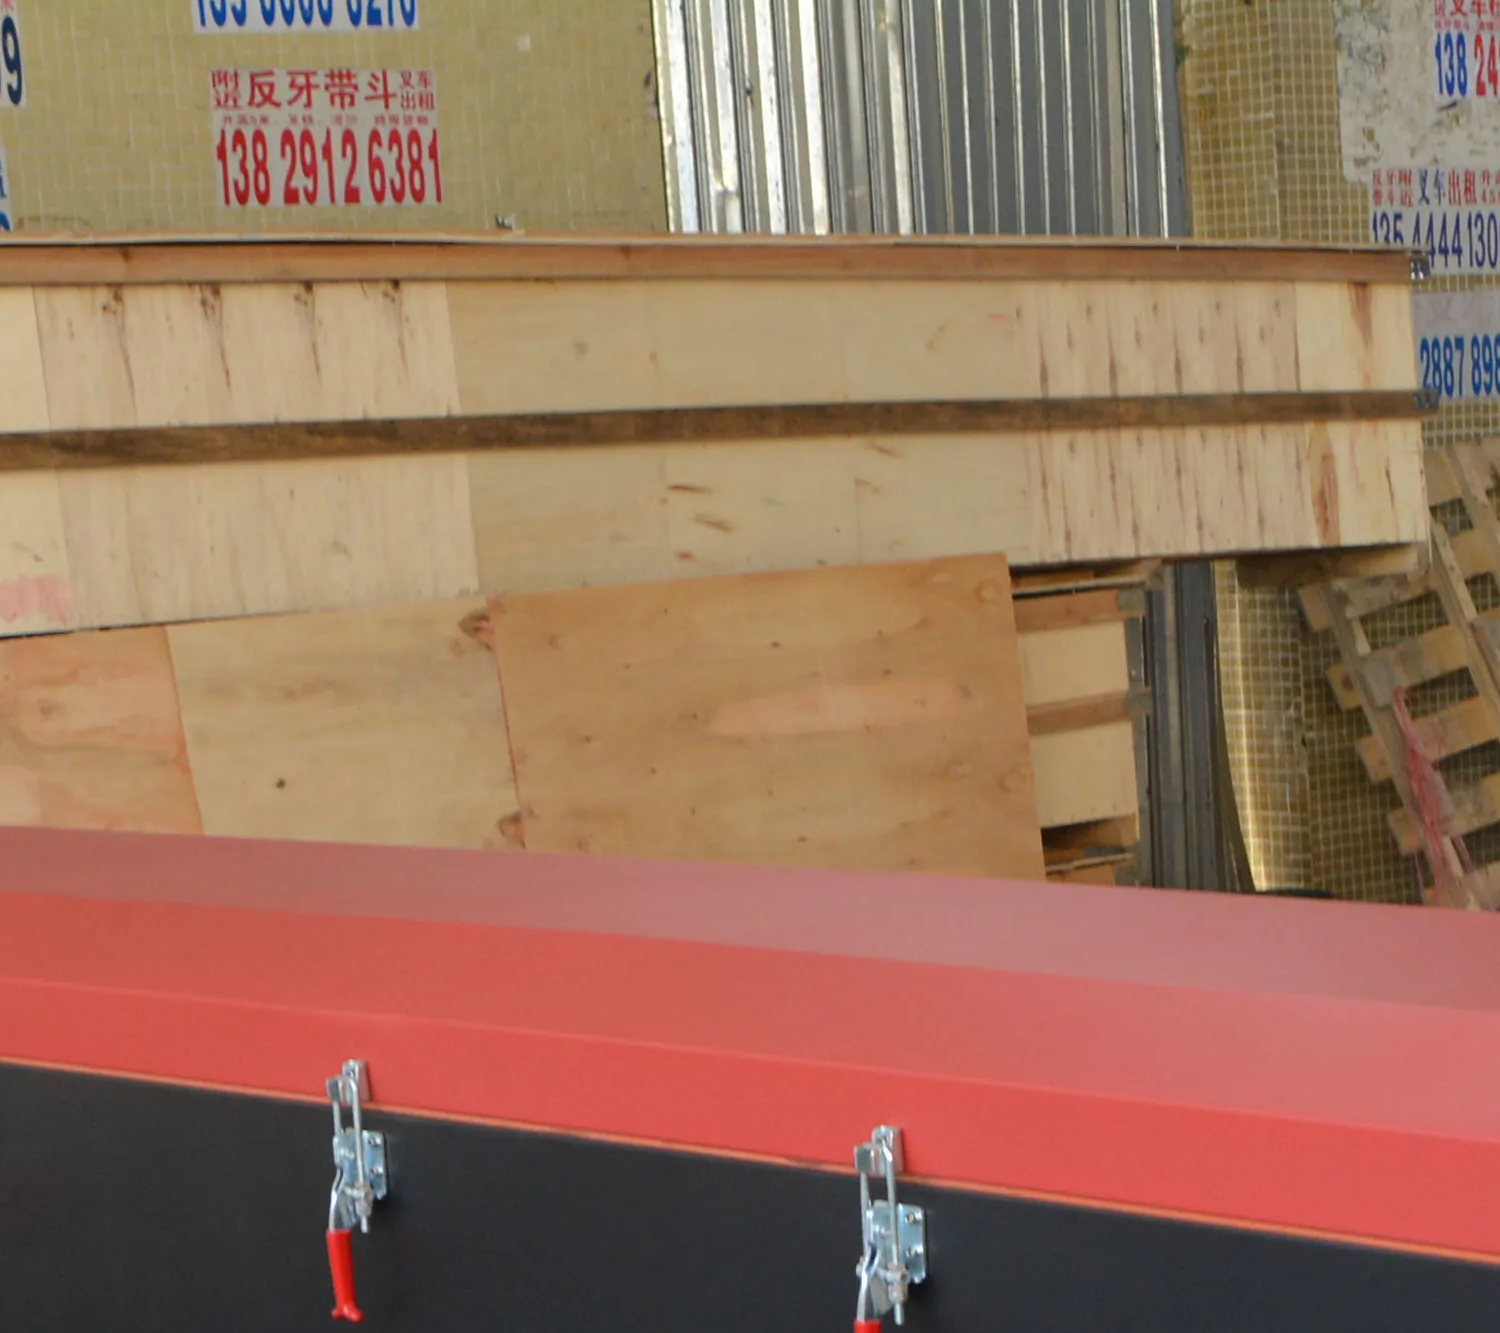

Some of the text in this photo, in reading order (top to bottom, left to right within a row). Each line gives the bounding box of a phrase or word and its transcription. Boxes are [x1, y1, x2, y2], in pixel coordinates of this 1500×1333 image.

[1435, 32, 1467, 98] 138
[217, 127, 442, 206] 138 2912 6381
[1420, 336, 1463, 397] 2887
